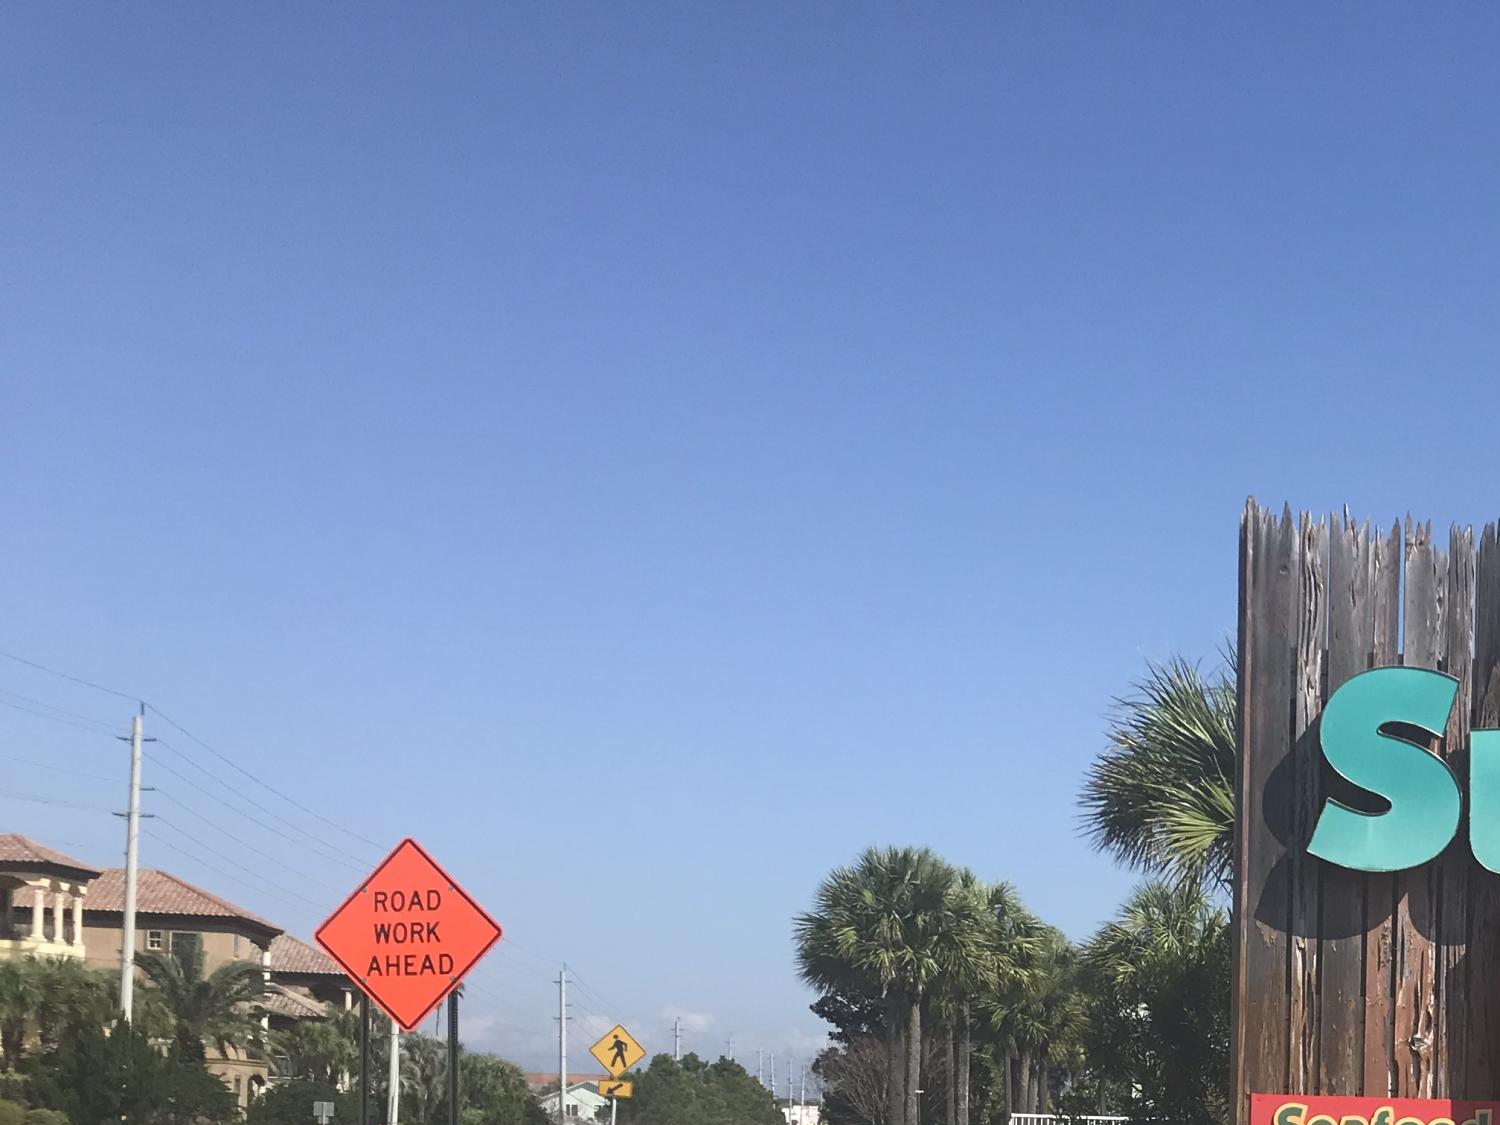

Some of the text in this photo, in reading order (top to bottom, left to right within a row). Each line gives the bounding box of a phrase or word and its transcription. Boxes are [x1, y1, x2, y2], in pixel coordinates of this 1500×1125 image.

[373, 889, 441, 912] ROAD
[374, 921, 441, 944] WORK
[366, 953, 454, 977] AHEAD
